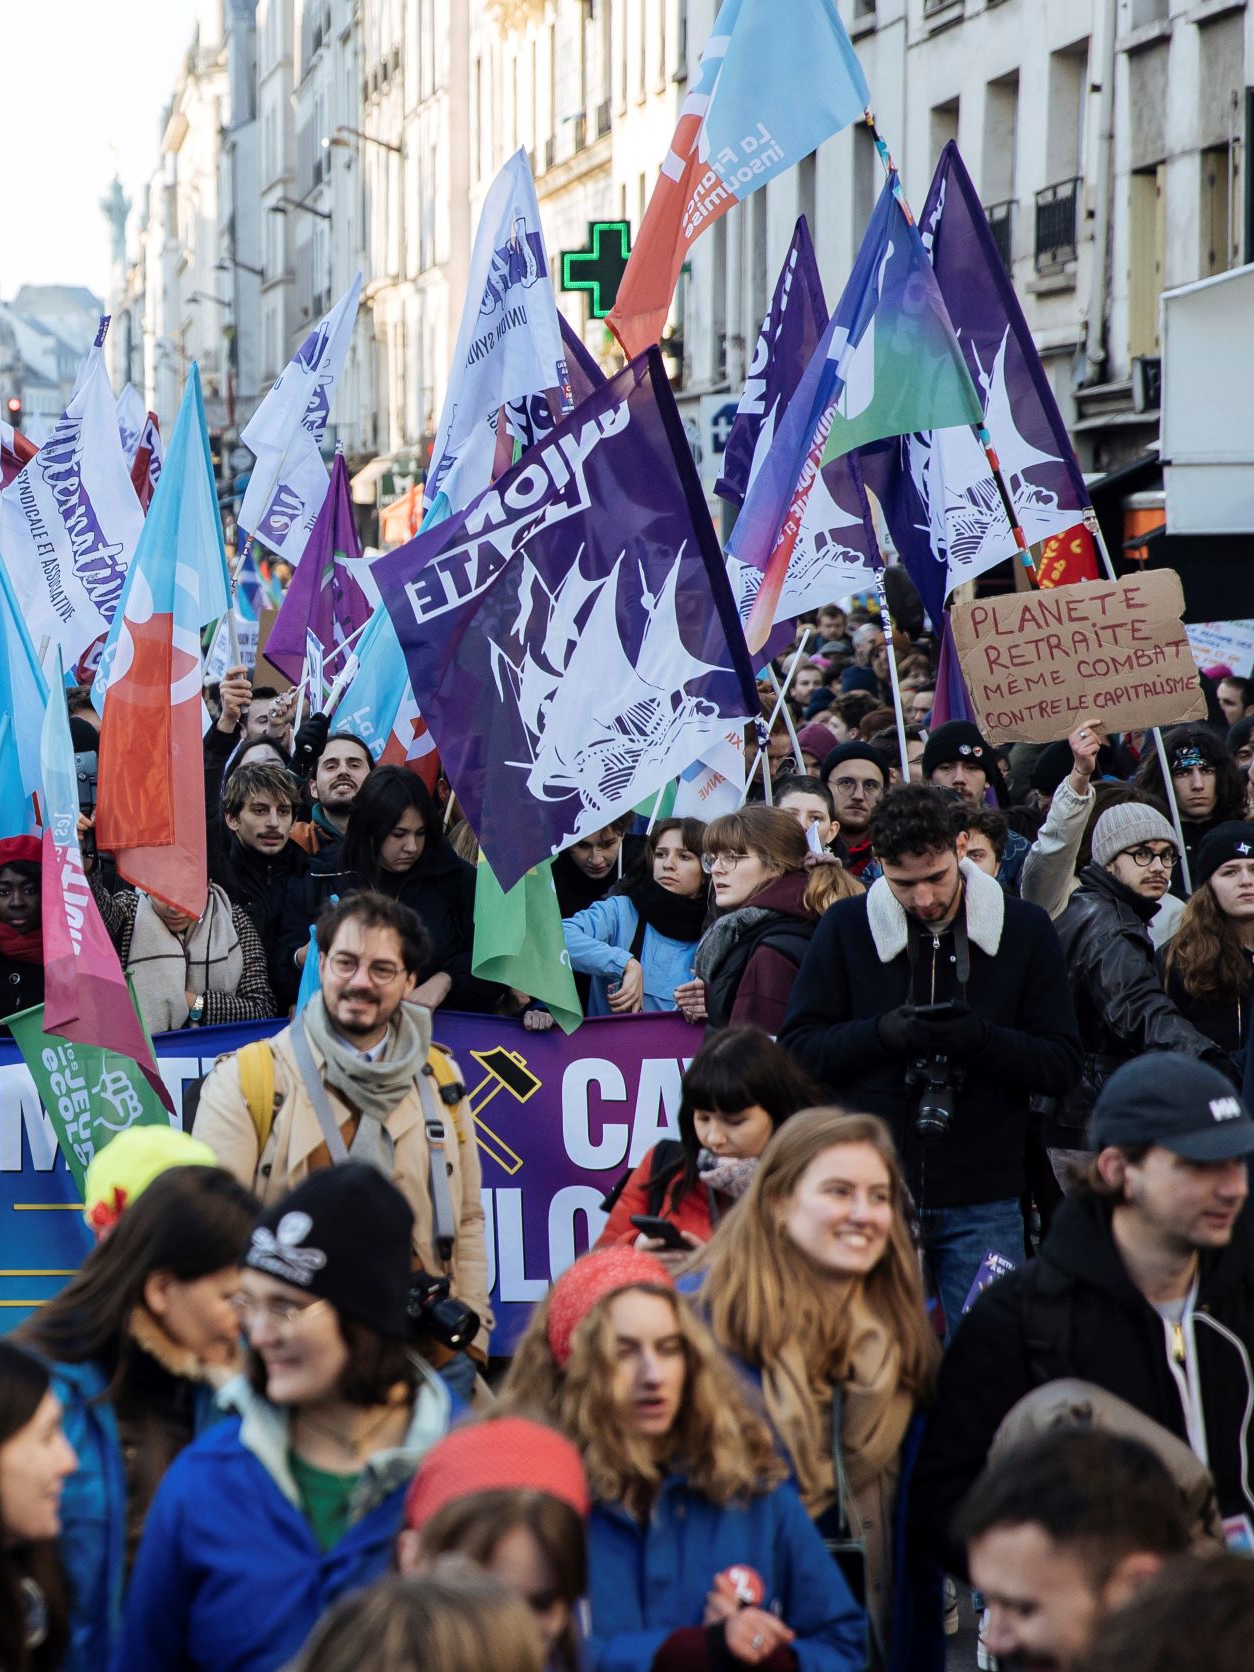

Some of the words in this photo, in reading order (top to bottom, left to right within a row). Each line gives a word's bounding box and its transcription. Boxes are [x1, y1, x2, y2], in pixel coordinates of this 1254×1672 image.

[16, 469, 49, 541] SYNDICALE
[36, 540, 55, 559] ET
[983, 669, 1065, 701] MÊME
[1077, 638, 1187, 679] COMBAT
[985, 697, 1063, 730] CONTRE
[1067, 692, 1089, 711] LE
[63, 1068, 96, 1164] JEUN
[561, 1056, 695, 1171] CA
